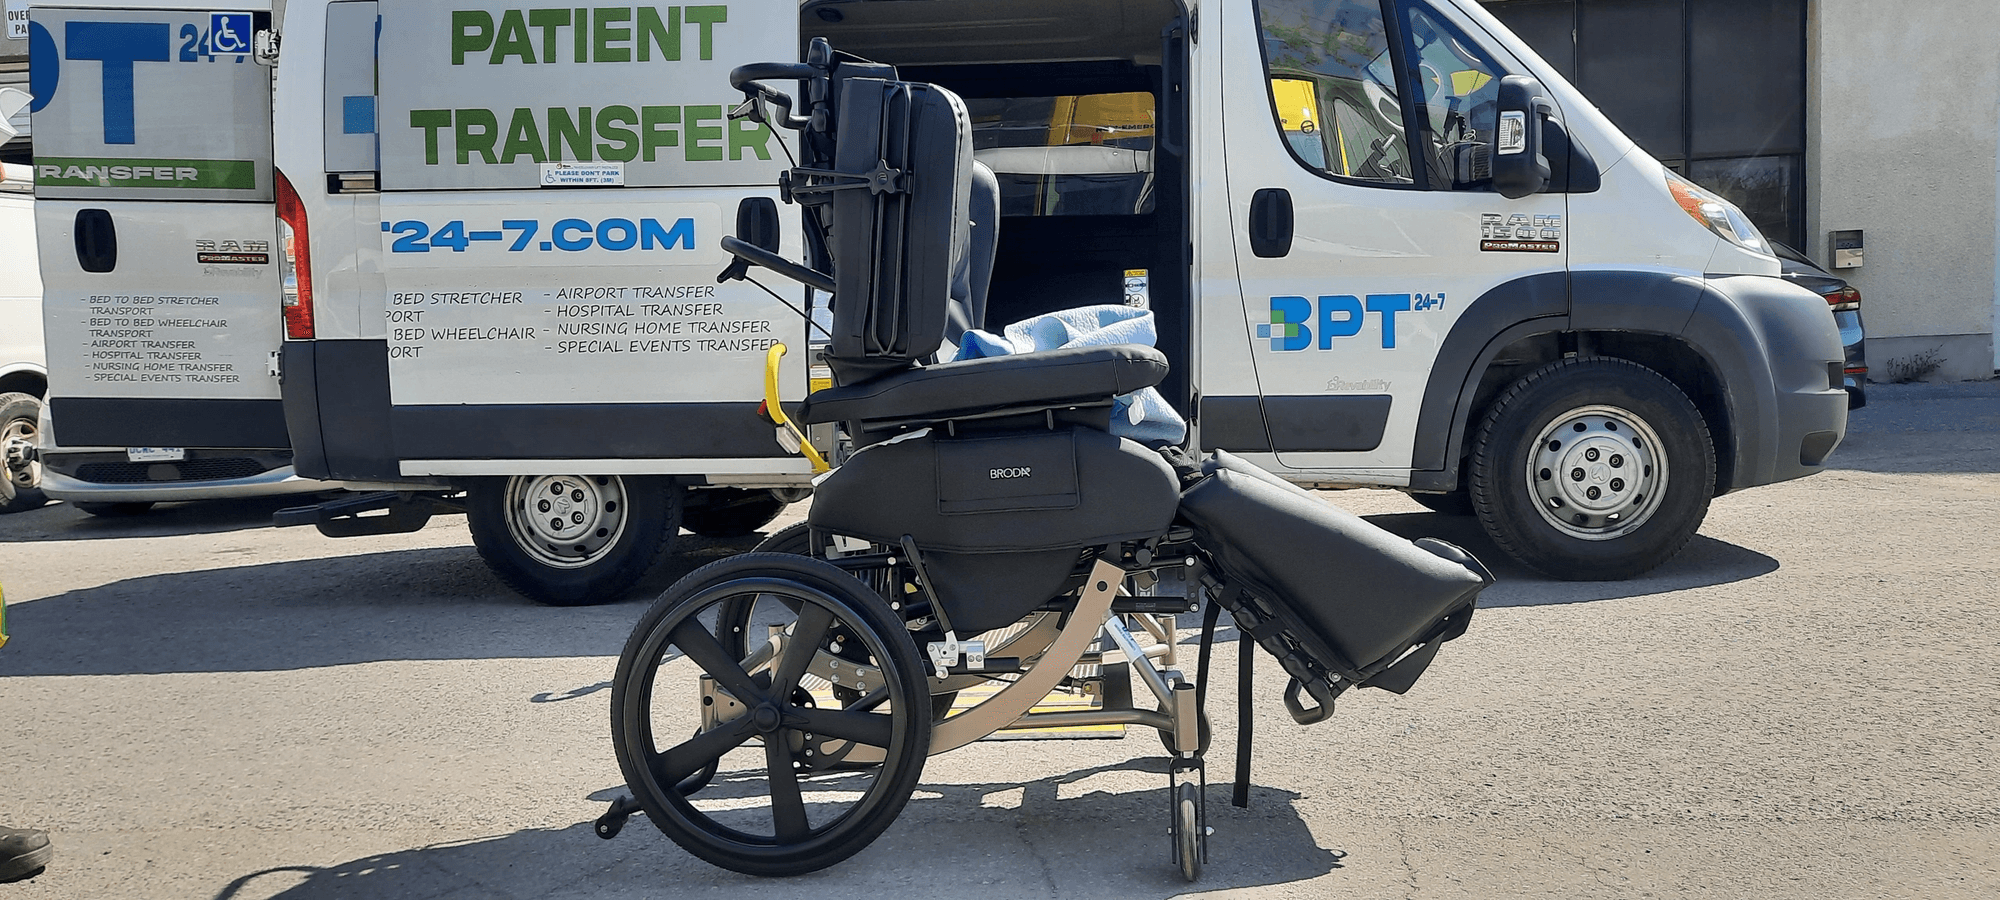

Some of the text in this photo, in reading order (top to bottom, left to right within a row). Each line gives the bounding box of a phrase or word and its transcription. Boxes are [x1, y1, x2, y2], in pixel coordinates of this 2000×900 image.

[452, 5, 727, 65] PATIENT
[410, 104, 771, 165] TRANSFER
[34, 165, 198, 182] RANSFER
[1481, 213, 1560, 227] RAM
[381, 218, 695, 252] 24-7.COM
[1481, 226, 1560, 240] 1500
[196, 240, 268, 252] RAM
[393, 292, 523, 305] BED STRETCHER
[556, 288, 628, 300] AIRPORT
[633, 286, 714, 298] TRANSFER
[90, 296, 111, 304] BED
[158, 297, 218, 305] STRETCHER
[90, 307, 154, 315] TRANSPORT
[557, 305, 634, 317] HOSPITAL
[640, 304, 723, 316] TRANSFER
[90, 318, 111, 326] BED
[115, 318, 129, 326] TO
[158, 319, 227, 328] WHEELCHAIR
[558, 323, 628, 335] NURSING
[634, 322, 682, 334] HOME
[688, 321, 770, 333] TRANSFER
[1257, 292, 1446, 351] BPT 24-7
[89, 330, 153, 338] TRANSPORT
[394, 328, 536, 340] BED WHEELCHAIR
[91, 340, 137, 348] AIRPORT
[140, 340, 195, 348] TRANSFER
[558, 341, 623, 353] SPECIAL
[630, 340, 690, 352] EVENTS
[92, 352, 144, 360] HOSPITAL
[147, 352, 202, 360] TRANSFER
[387, 346, 423, 358] ORT
[93, 362, 140, 371] NURSING
[144, 363, 174, 371] HOME
[178, 364, 233, 372] TRANSFER
[94, 374, 137, 382] SPECIAL
[141, 374, 182, 382] EVENTS
[186, 374, 240, 382] TRANSFER
